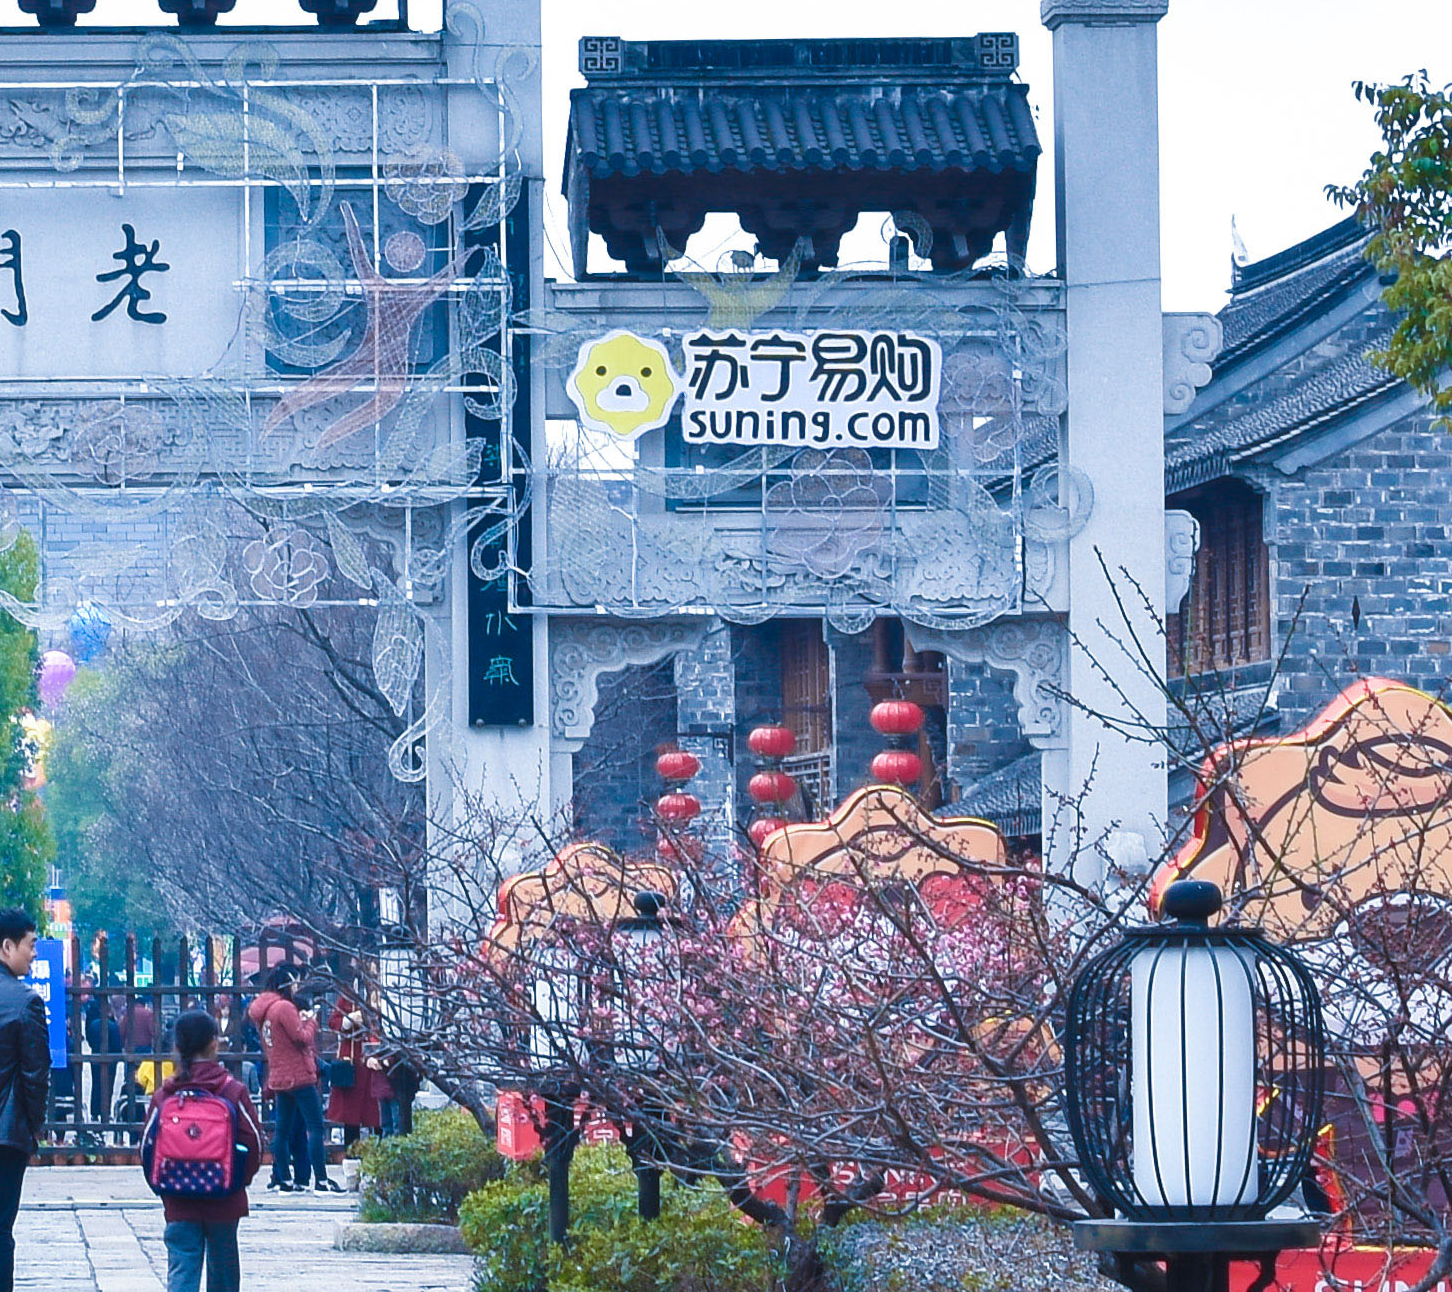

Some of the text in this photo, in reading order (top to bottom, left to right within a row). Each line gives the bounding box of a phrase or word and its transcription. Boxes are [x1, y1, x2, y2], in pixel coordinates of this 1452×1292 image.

[689, 333, 933, 402] 苏宁易购
[688, 409, 931, 442] suning.com
